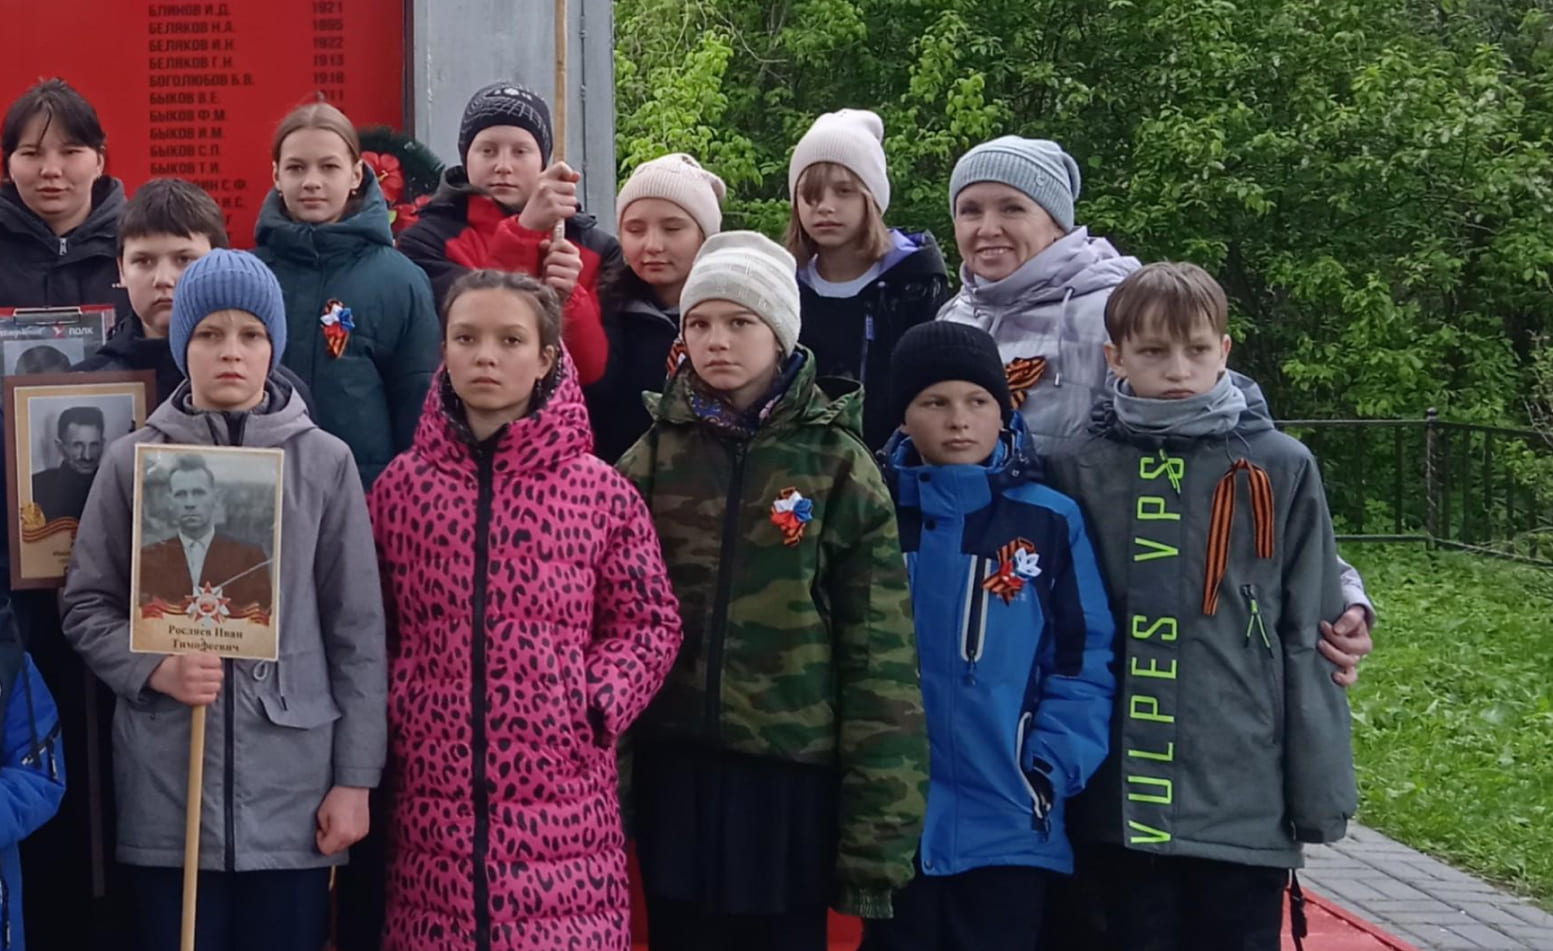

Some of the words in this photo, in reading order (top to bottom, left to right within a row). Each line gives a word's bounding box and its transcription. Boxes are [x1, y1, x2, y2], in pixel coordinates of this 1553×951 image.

[149, 21, 208, 34] БЕЛЯКОВ
[149, 39, 208, 52] БЕЛЯКОВ
[149, 57, 208, 69] БЕЛЯКОВ
[149, 74, 228, 87] БОГОЛЮБОВ
[150, 92, 194, 104] БЫКОВ
[150, 110, 195, 122] БЫКОВ
[150, 128, 195, 140] БЫКОВ
[150, 145, 195, 157] БЫКОВ
[150, 162, 195, 174] БЫКОВ
[1133, 456, 1186, 562] VPS
[215, 627, 243, 639] Иван
[1127, 614, 1178, 844] VULPES
